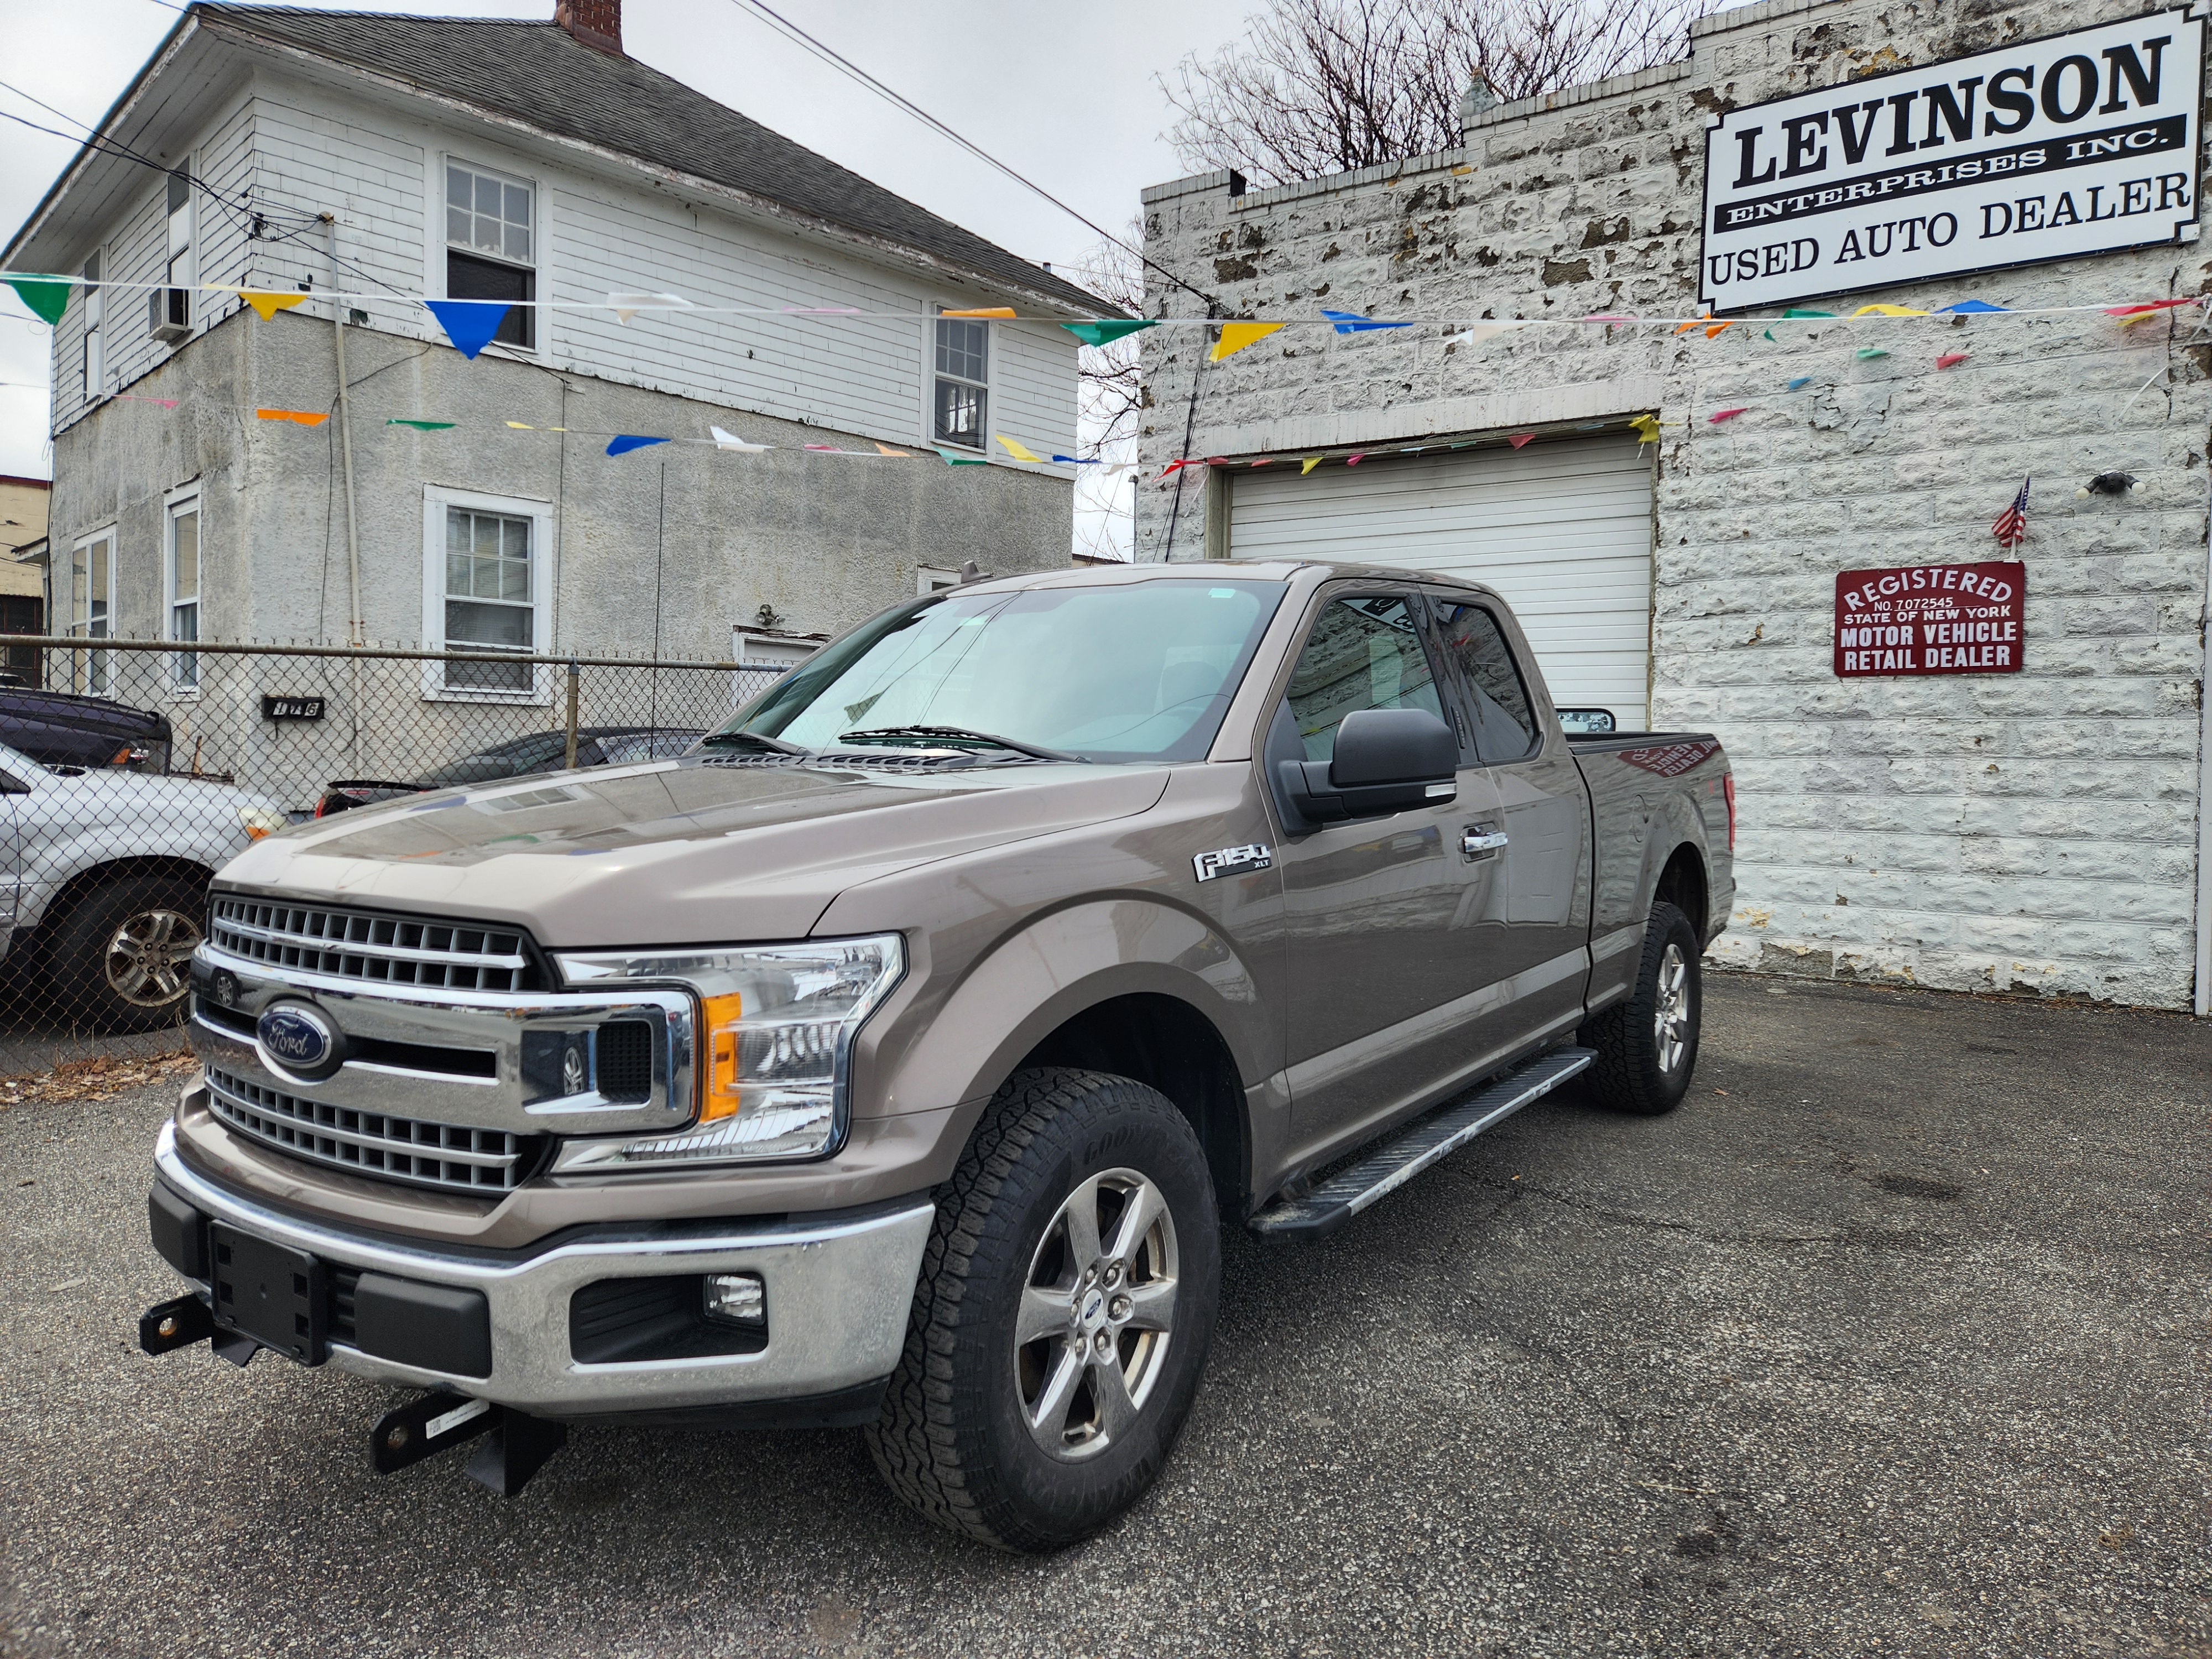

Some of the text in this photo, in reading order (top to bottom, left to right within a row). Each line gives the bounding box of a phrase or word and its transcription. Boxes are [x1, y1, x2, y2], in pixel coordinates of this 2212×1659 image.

[1733, 35, 2171, 189] LEVINSON
[1726, 128, 2169, 225] ENTERPRISES INC.
[1709, 173, 2190, 285] USED AUTO DEALER
[1844, 569, 2011, 611] REGISTERED
[1874, 597, 1953, 611] NO. 7072545
[1844, 606, 2011, 624] STATE OF NEW YORK
[1840, 622, 2016, 648] MOTOR VEHICLE
[1845, 646, 2011, 670] RETAIL DEALER
[1254, 859, 1269, 869] XLT
[268, 1019, 308, 1056] Ford
